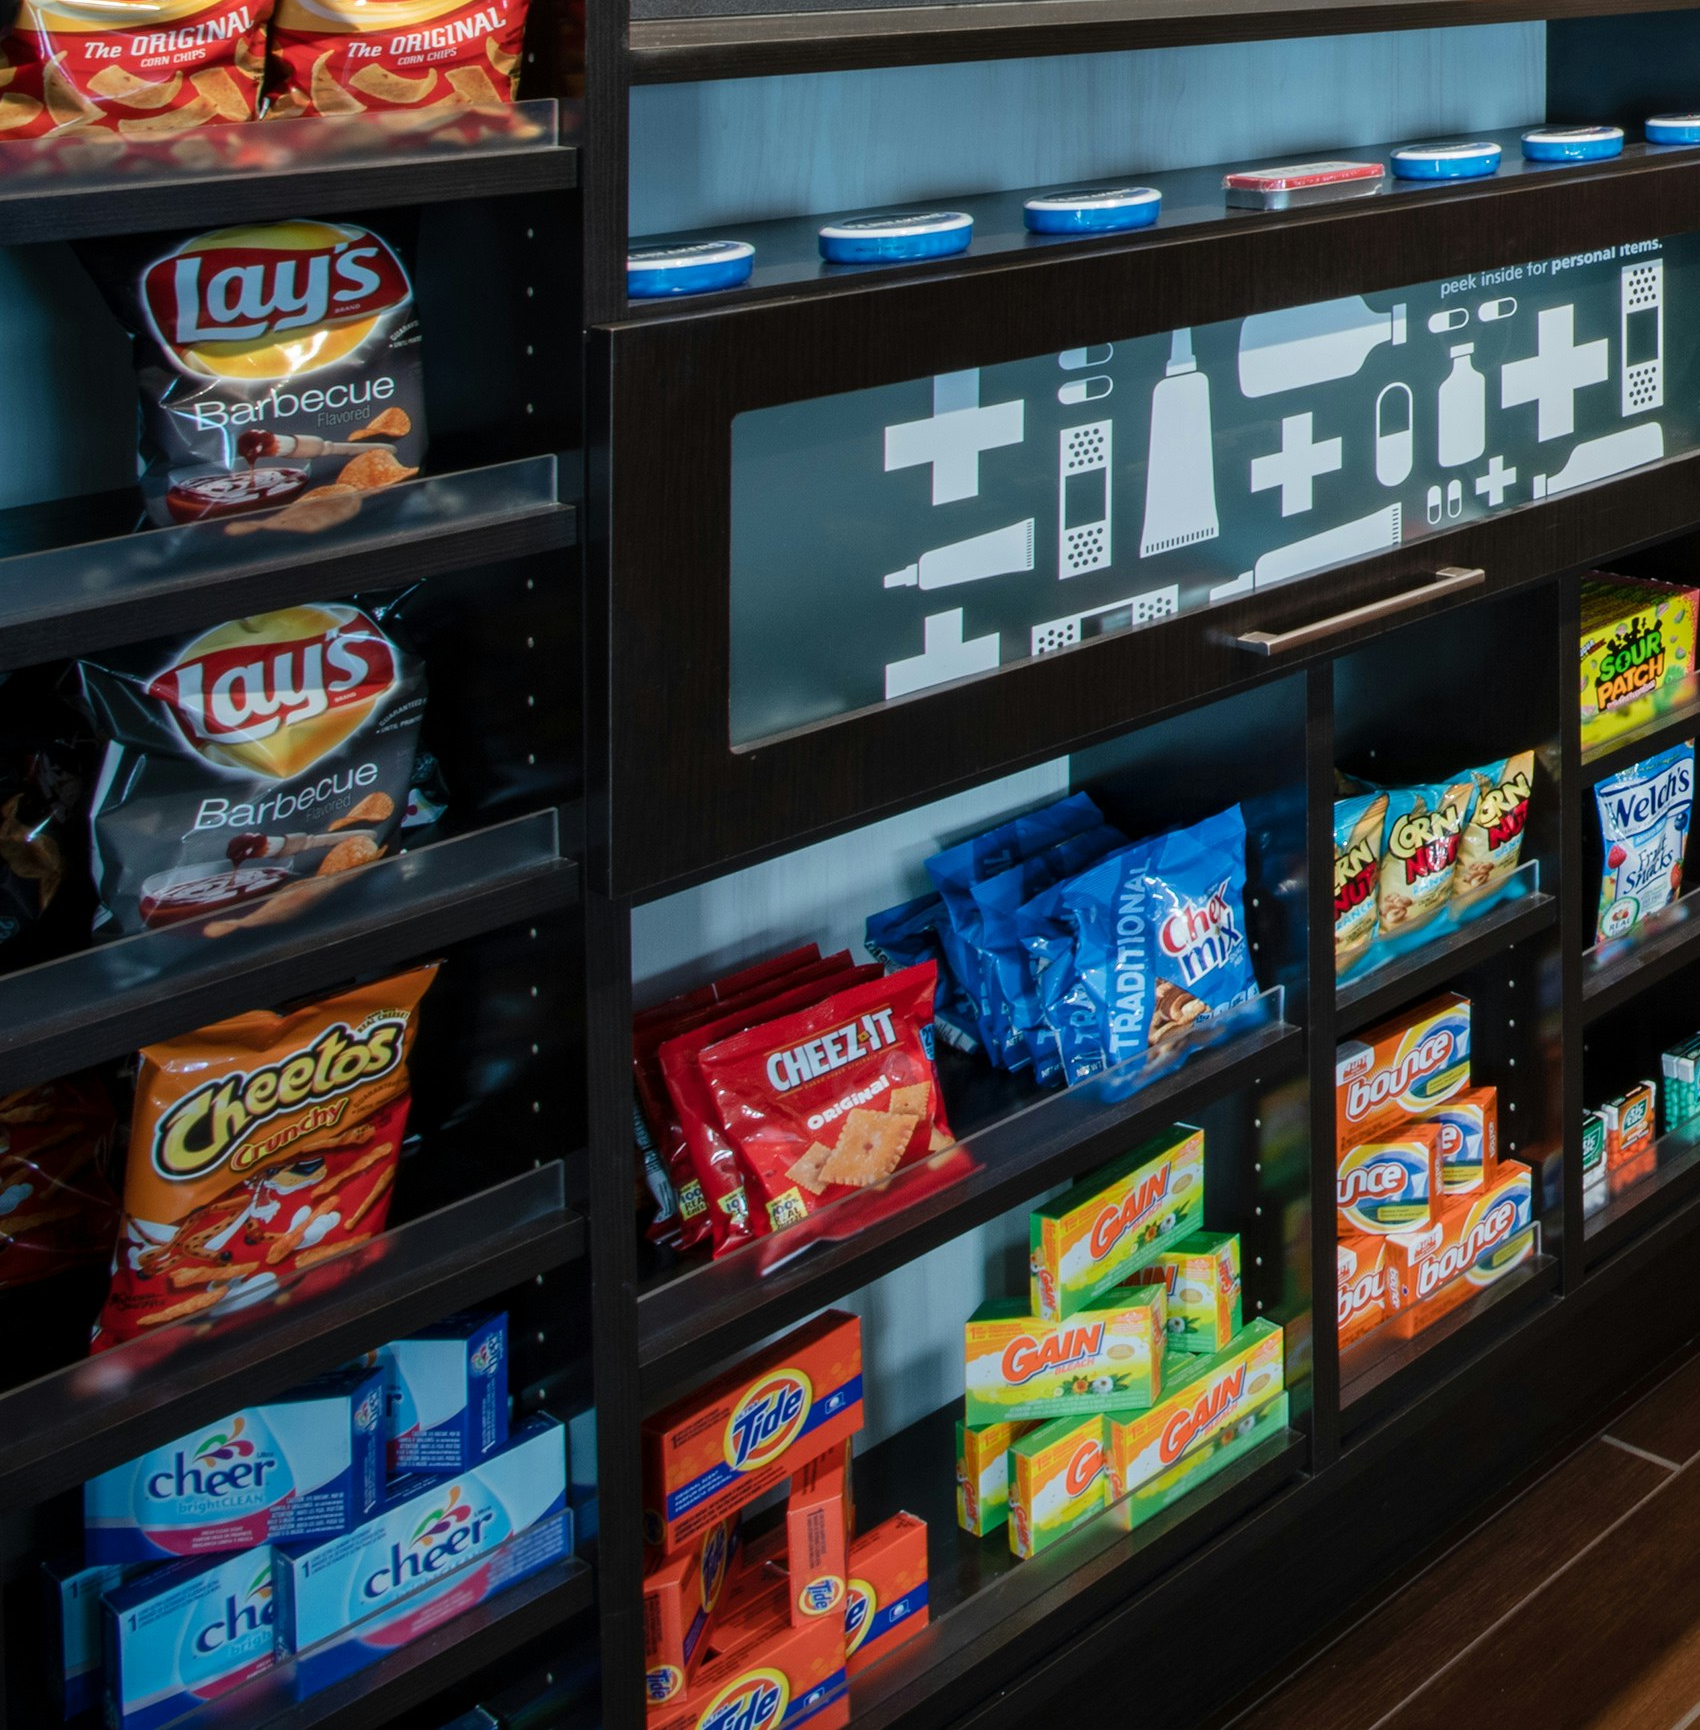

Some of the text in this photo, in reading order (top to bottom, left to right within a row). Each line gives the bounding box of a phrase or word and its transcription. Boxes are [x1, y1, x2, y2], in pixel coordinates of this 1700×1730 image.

[84, 6, 255, 60] The ORIGINAL
[348, 6, 508, 59] The ORIGINAL
[175, 243, 382, 343] Lay's
[1440, 276, 1477, 299] peek
[1481, 266, 1524, 288] inside
[1527, 260, 1549, 280] for
[1551, 245, 1616, 276] personal
[193, 375, 396, 433] Barbecue
[317, 405, 371, 429] Flavored
[174, 628, 373, 746] Lay's
[1597, 653, 1664, 712] PATCH
[1599, 631, 1663, 681] SOUR
[194, 761, 378, 831] Barbecue
[1607, 767, 1691, 828] Welch's
[1389, 805, 1464, 860] CORN
[1622, 849, 1674, 895] Snacks
[1158, 877, 1231, 957] Chex
[1108, 860, 1151, 1055] TRADITIONAL
[159, 1023, 405, 1175] Cheetos
[1346, 1030, 1453, 1122] bounce
[231, 1097, 349, 1171] Crunchy
[1089, 1162, 1170, 1260] GAIN
[1417, 1200, 1516, 1297] bounce
[1000, 1321, 1106, 1383] GAIN
[732, 1384, 805, 1470] Tide
[1158, 1362, 1248, 1464] GAIN
[145, 1450, 275, 1502] cheer
[361, 1505, 493, 1605] cheer
